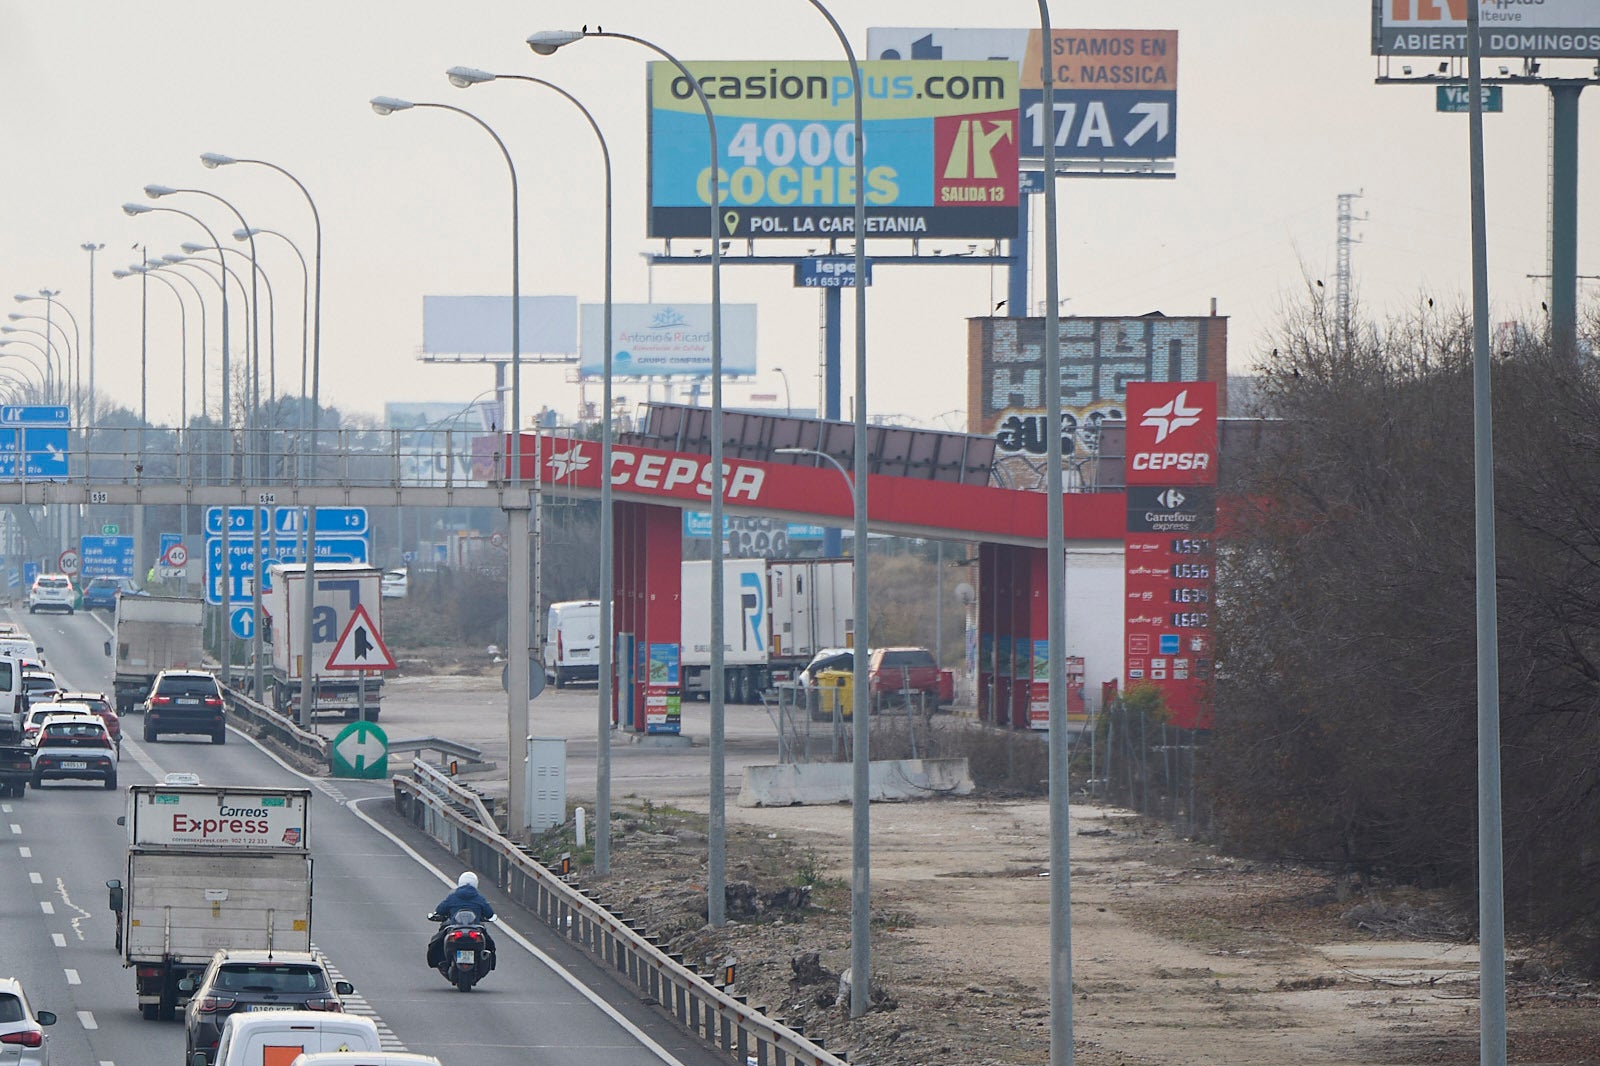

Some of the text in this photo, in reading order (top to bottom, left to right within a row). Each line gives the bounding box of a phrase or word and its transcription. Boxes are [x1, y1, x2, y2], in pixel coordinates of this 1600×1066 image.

[1481, 11, 1522, 22] Iteuve
[1053, 38, 1166, 56] STAMOS EN
[1393, 35, 1600, 50] ABIERT DOMINGOS
[1040, 65, 1167, 83] .C. NASSICA
[1026, 102, 1114, 147] 17A
[728, 123, 866, 166] 4000
[696, 167, 899, 205] COCHES
[941, 187, 1005, 202] SALIDA 13
[750, 217, 927, 232] POL. LA CARETANIA
[1132, 453, 1209, 470] CEPSA
[602, 451, 766, 501] CEPSA
[345, 516, 360, 526] 13
[1145, 512, 1197, 523] Carrefour
[1152, 523, 1190, 531] express
[171, 552, 185, 560] 40
[220, 806, 268, 817] Correos
[173, 814, 269, 837] Express
